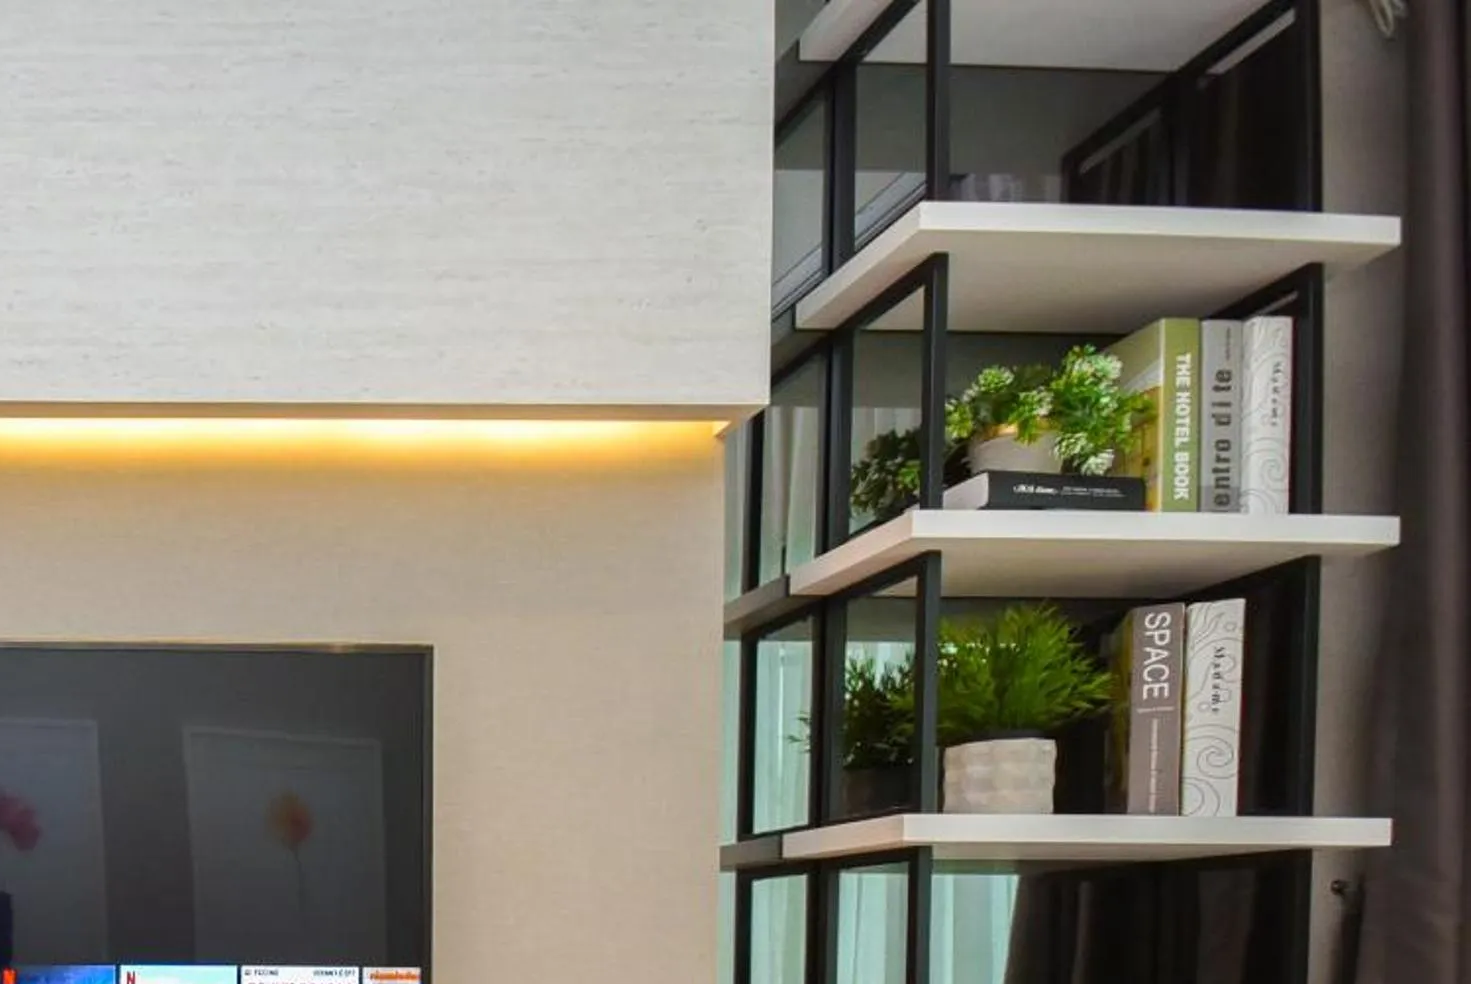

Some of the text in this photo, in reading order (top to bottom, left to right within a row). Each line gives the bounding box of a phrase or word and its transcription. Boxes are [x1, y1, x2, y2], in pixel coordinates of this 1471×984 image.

[1173, 353, 1192, 500] THE HOTEL BOOK
[1213, 439, 1231, 512] entro
[1142, 612, 1172, 700] SPACE
